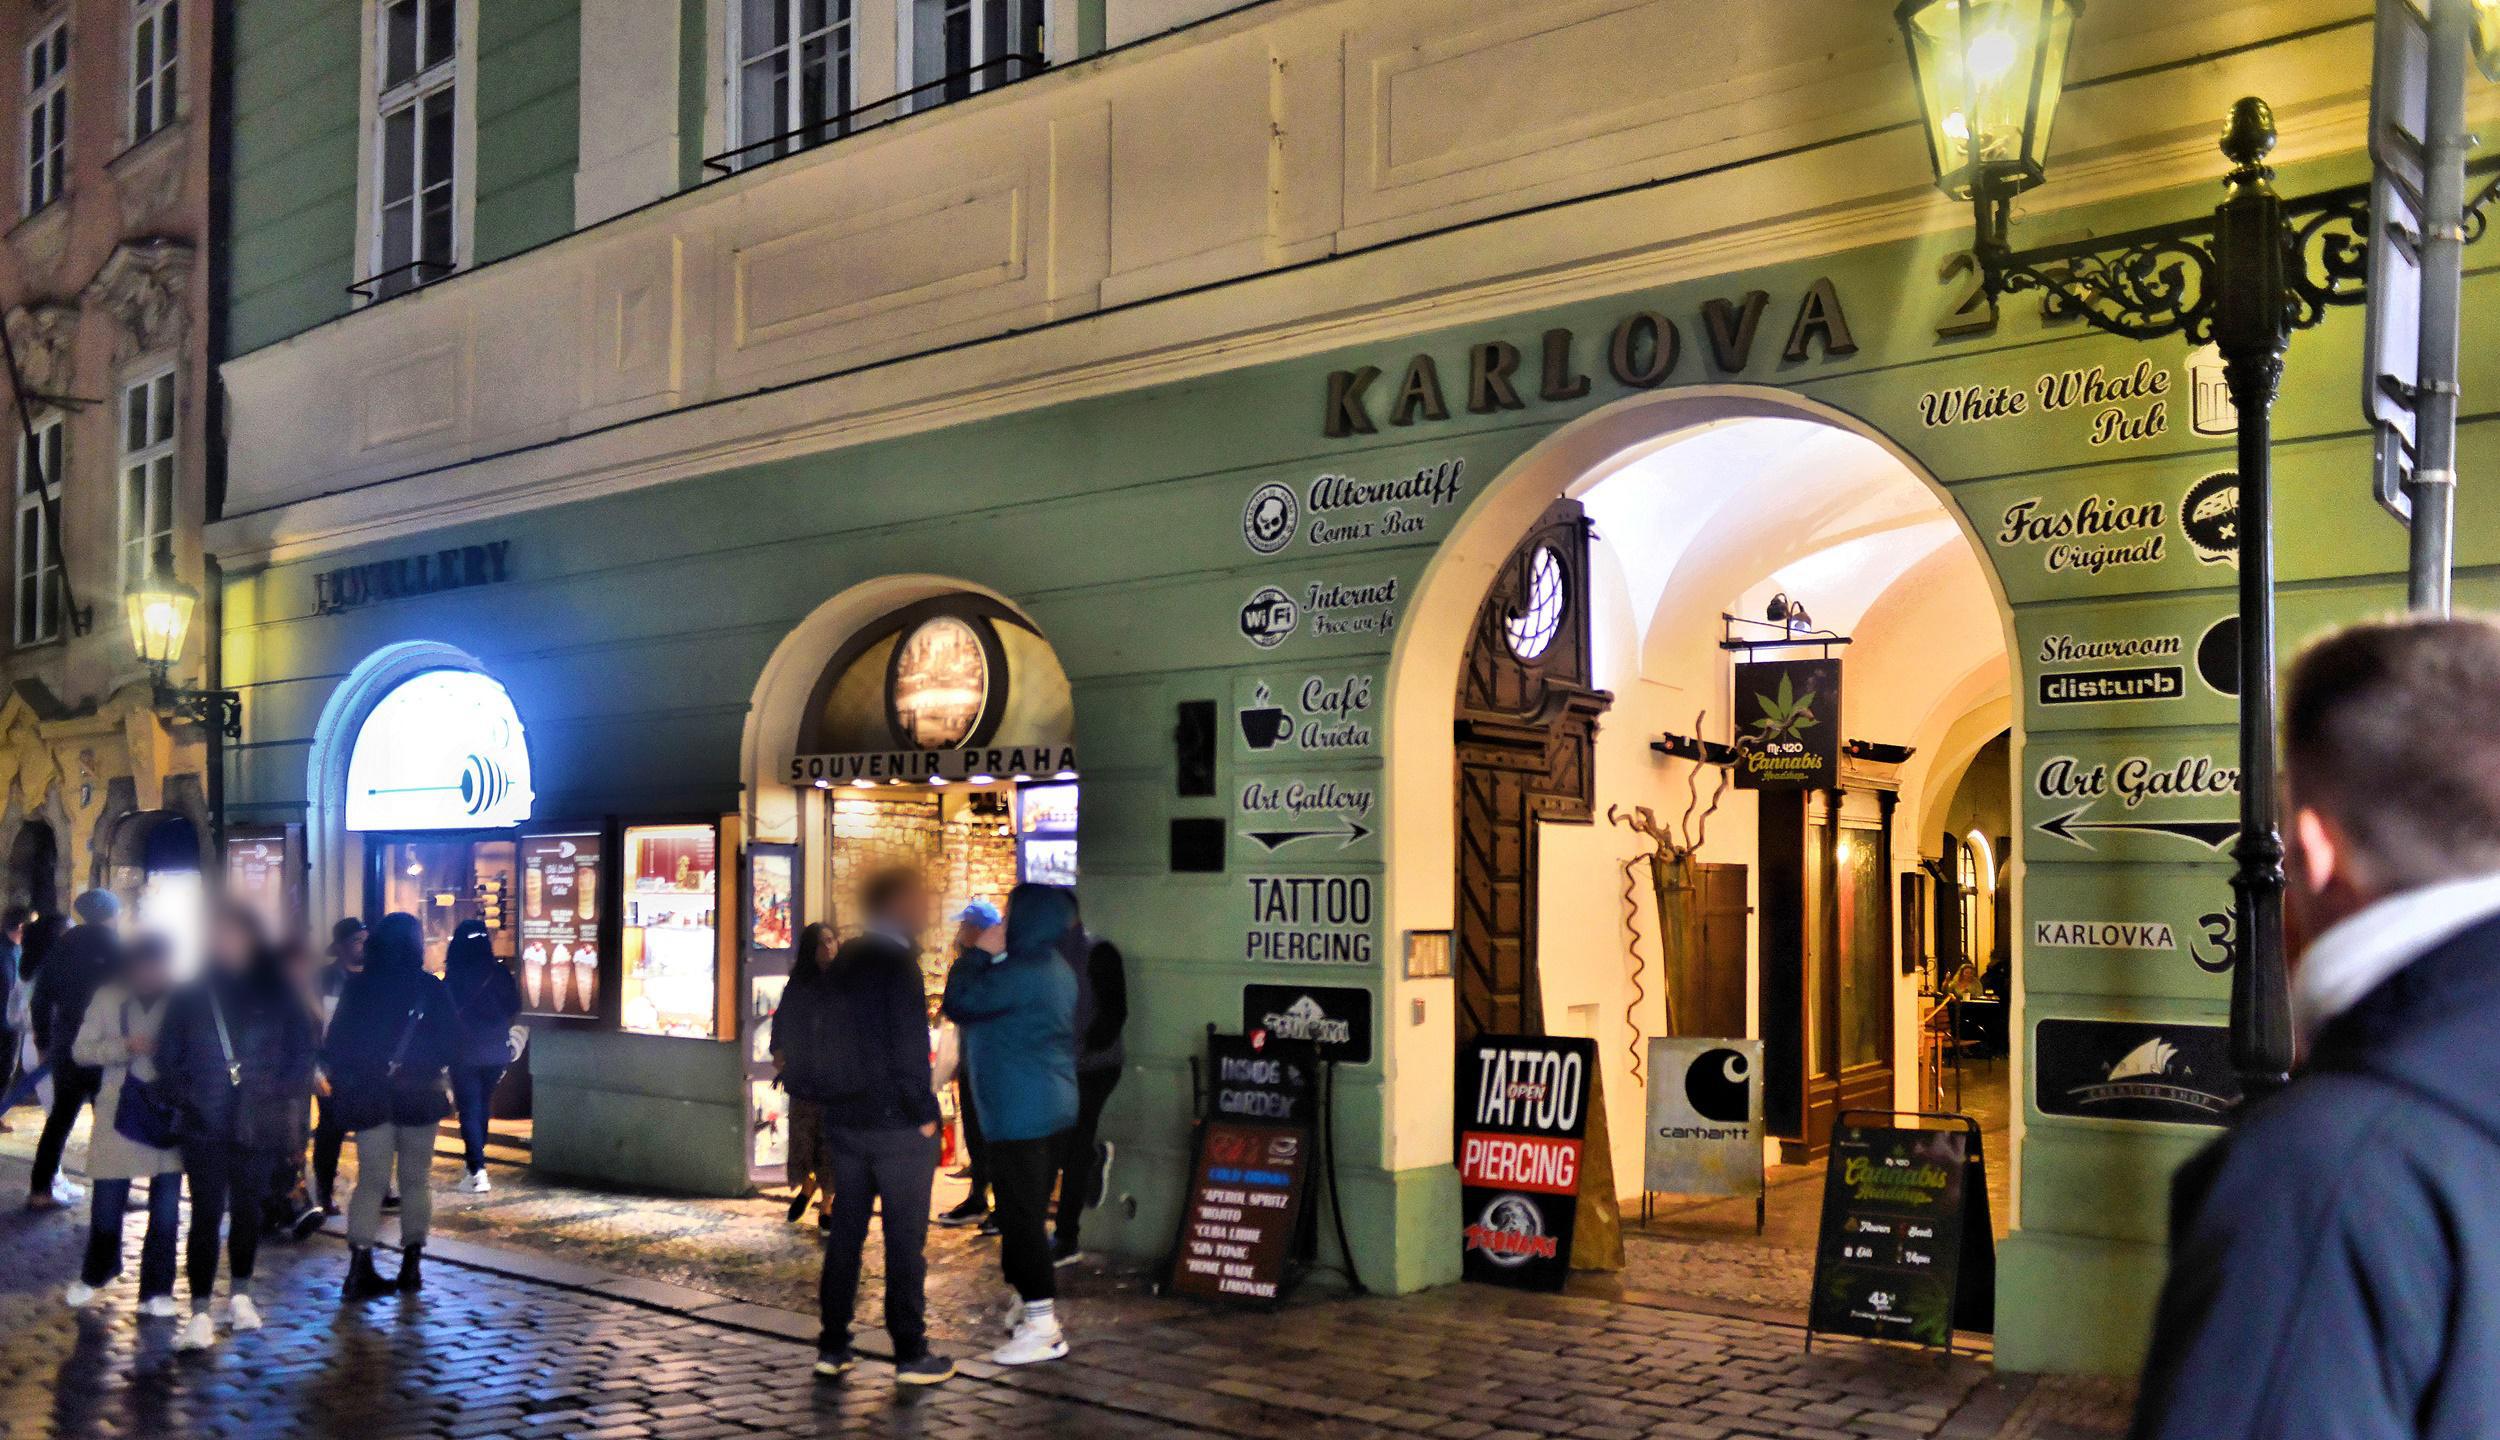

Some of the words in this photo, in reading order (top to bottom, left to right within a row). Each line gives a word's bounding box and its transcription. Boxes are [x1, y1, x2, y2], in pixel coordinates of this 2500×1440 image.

[1323, 276, 1859, 438] KARLOVA
[1921, 386, 2027, 427] White
[2038, 360, 2170, 409] Whale
[2090, 402, 2168, 445] Pub
[1309, 460, 1464, 511] Alternatiff
[1310, 520, 1374, 544] Comix
[1381, 510, 1425, 535] Bar
[1999, 495, 2165, 545] Fashion
[2049, 536, 2165, 574] Original
[1304, 579, 1397, 610] Internet
[1315, 615, 1349, 634] Free
[2040, 636, 2182, 662] Showroom
[1302, 677, 1371, 720] Café
[2047, 672, 2175, 699] disturb
[791, 752, 940, 779] SOUVENIR
[964, 747, 1076, 772] PRAHA
[1748, 751, 1823, 773] Cannabis
[2039, 759, 2104, 796] Art
[2117, 757, 2240, 807] Galler
[1243, 783, 1280, 811] Art
[1286, 783, 1371, 816] Gallery
[1249, 878, 1371, 924] TATTOO
[1247, 931, 1370, 962] PIERCING
[2038, 924, 2174, 948] KARLOVKA
[1477, 1048, 1582, 1130] TATTOO
[1507, 1083, 1546, 1100] OPEN
[1660, 1126, 1749, 1140] carhartt
[1464, 1139, 1574, 1187] PIERCING
